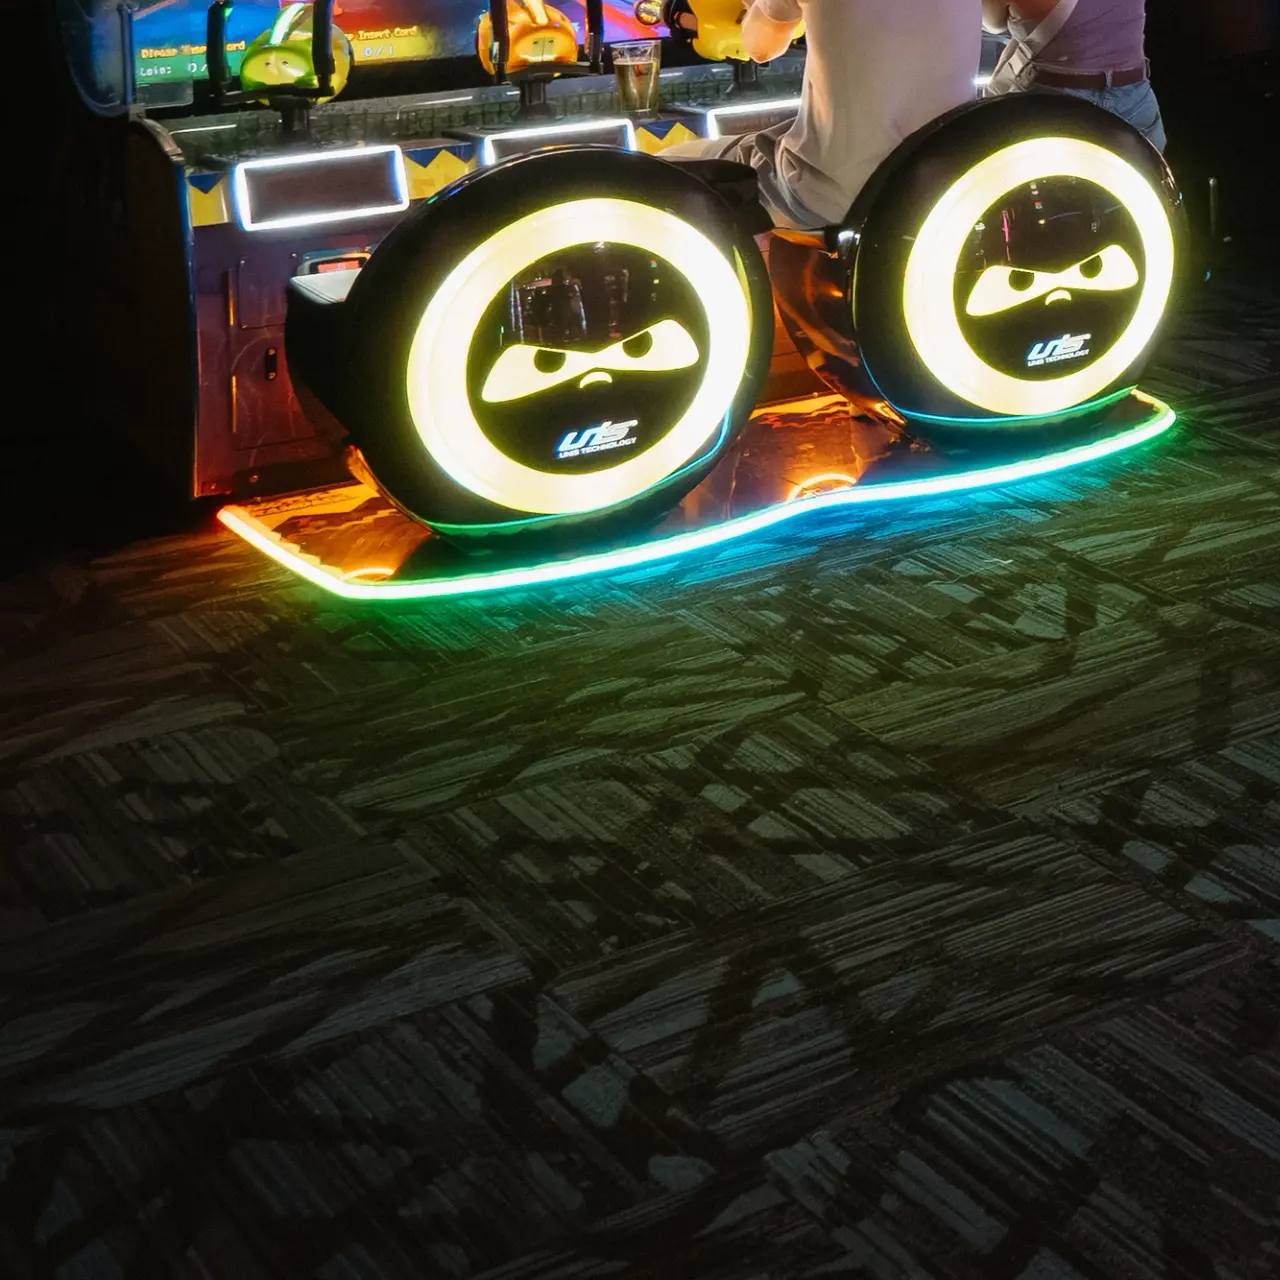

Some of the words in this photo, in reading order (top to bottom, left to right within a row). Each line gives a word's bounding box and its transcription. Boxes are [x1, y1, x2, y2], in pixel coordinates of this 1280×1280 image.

[358, 29, 390, 41] Insert
[394, 26, 419, 37] Card
[559, 449, 580, 458] UNIS
[580, 437, 637, 453] TECHNOLOGY
